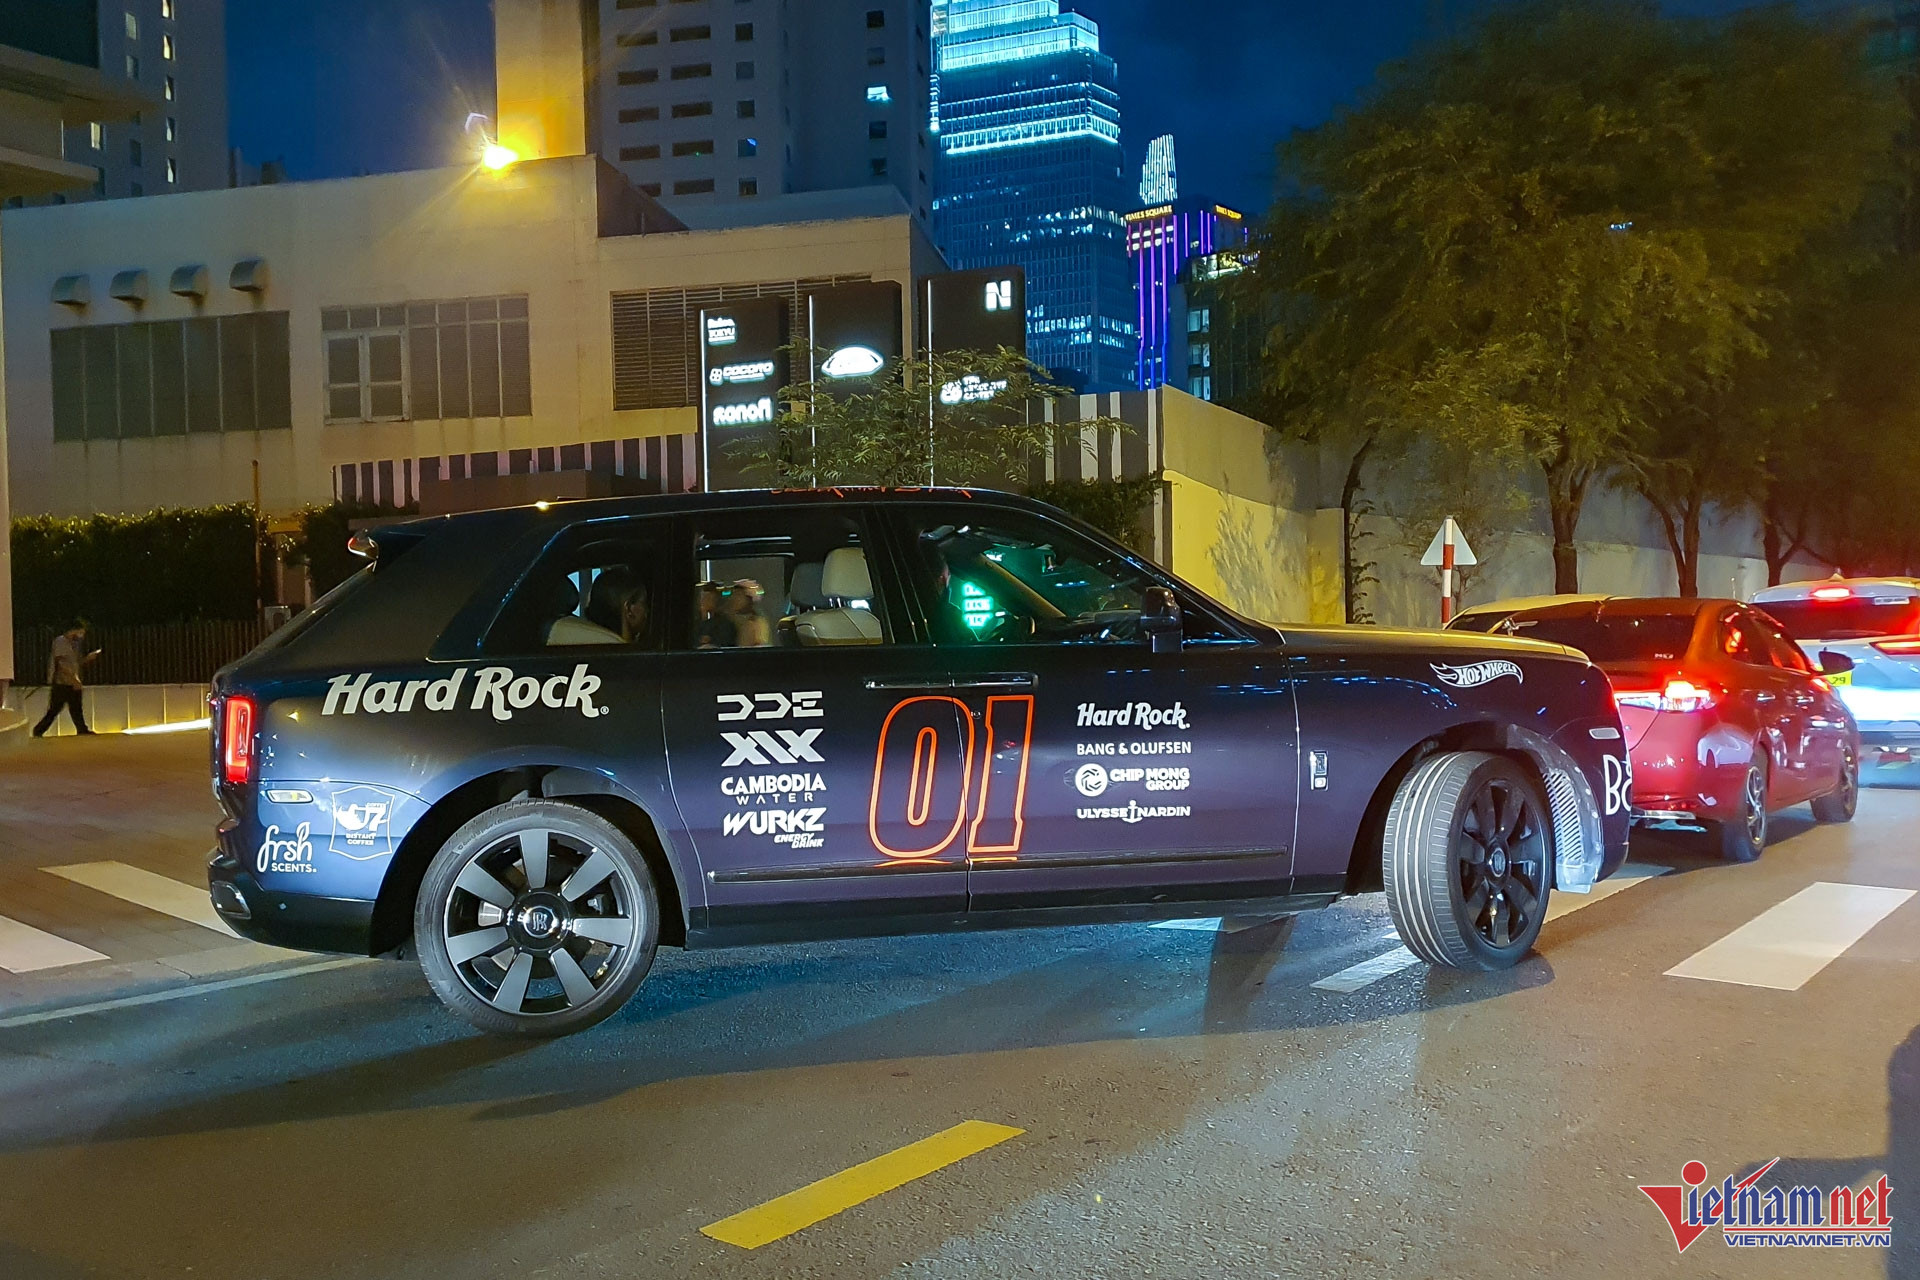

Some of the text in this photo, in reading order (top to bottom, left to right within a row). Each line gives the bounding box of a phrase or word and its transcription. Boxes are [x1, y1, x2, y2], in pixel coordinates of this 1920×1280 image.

[1145, 205, 1172, 217] SQUARE
[321, 664, 602, 721] Hard Rock
[1077, 702, 1133, 727] Hard
[1077, 742, 1192, 755] BANG & OLUFSEN
[869, 695, 1034, 858] 01
[1110, 767, 1190, 782] CHIP MONG
[721, 773, 827, 796] CAMBODIA
[1145, 779, 1190, 791] GROUP
[736, 792, 814, 805] WATER
[723, 807, 827, 836] WURKZ
[1076, 806, 1191, 819] ULYSSE NARDIN
[257, 821, 313, 873] frsh
